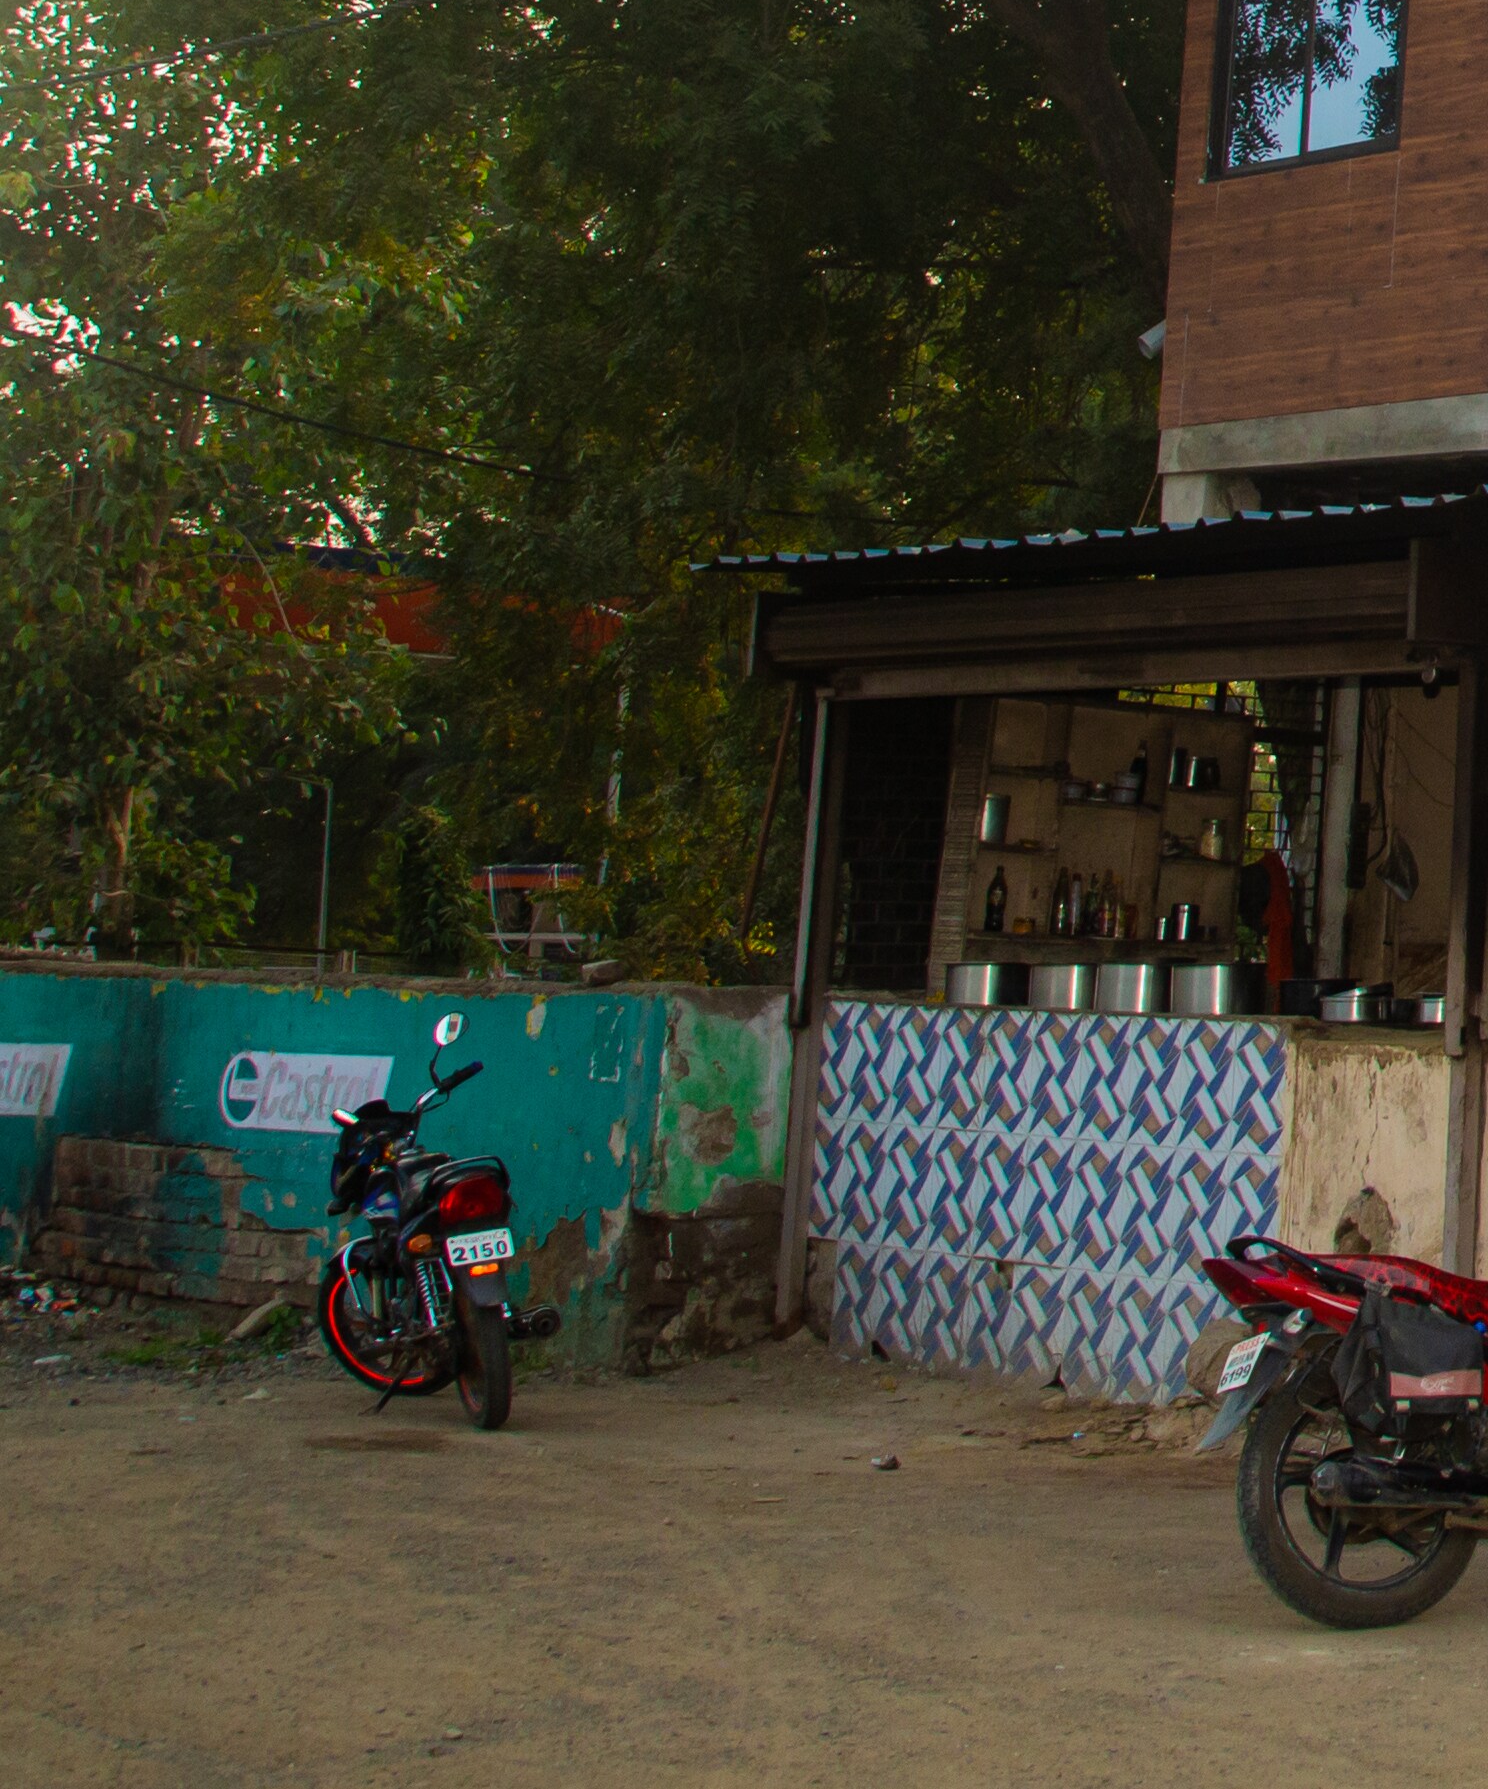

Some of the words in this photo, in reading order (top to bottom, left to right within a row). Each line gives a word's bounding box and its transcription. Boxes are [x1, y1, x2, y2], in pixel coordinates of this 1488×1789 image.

[260, 1059, 381, 1121] Castrol
[452, 1240, 509, 1262] 2150
[1220, 1363, 1252, 1387] 6199
